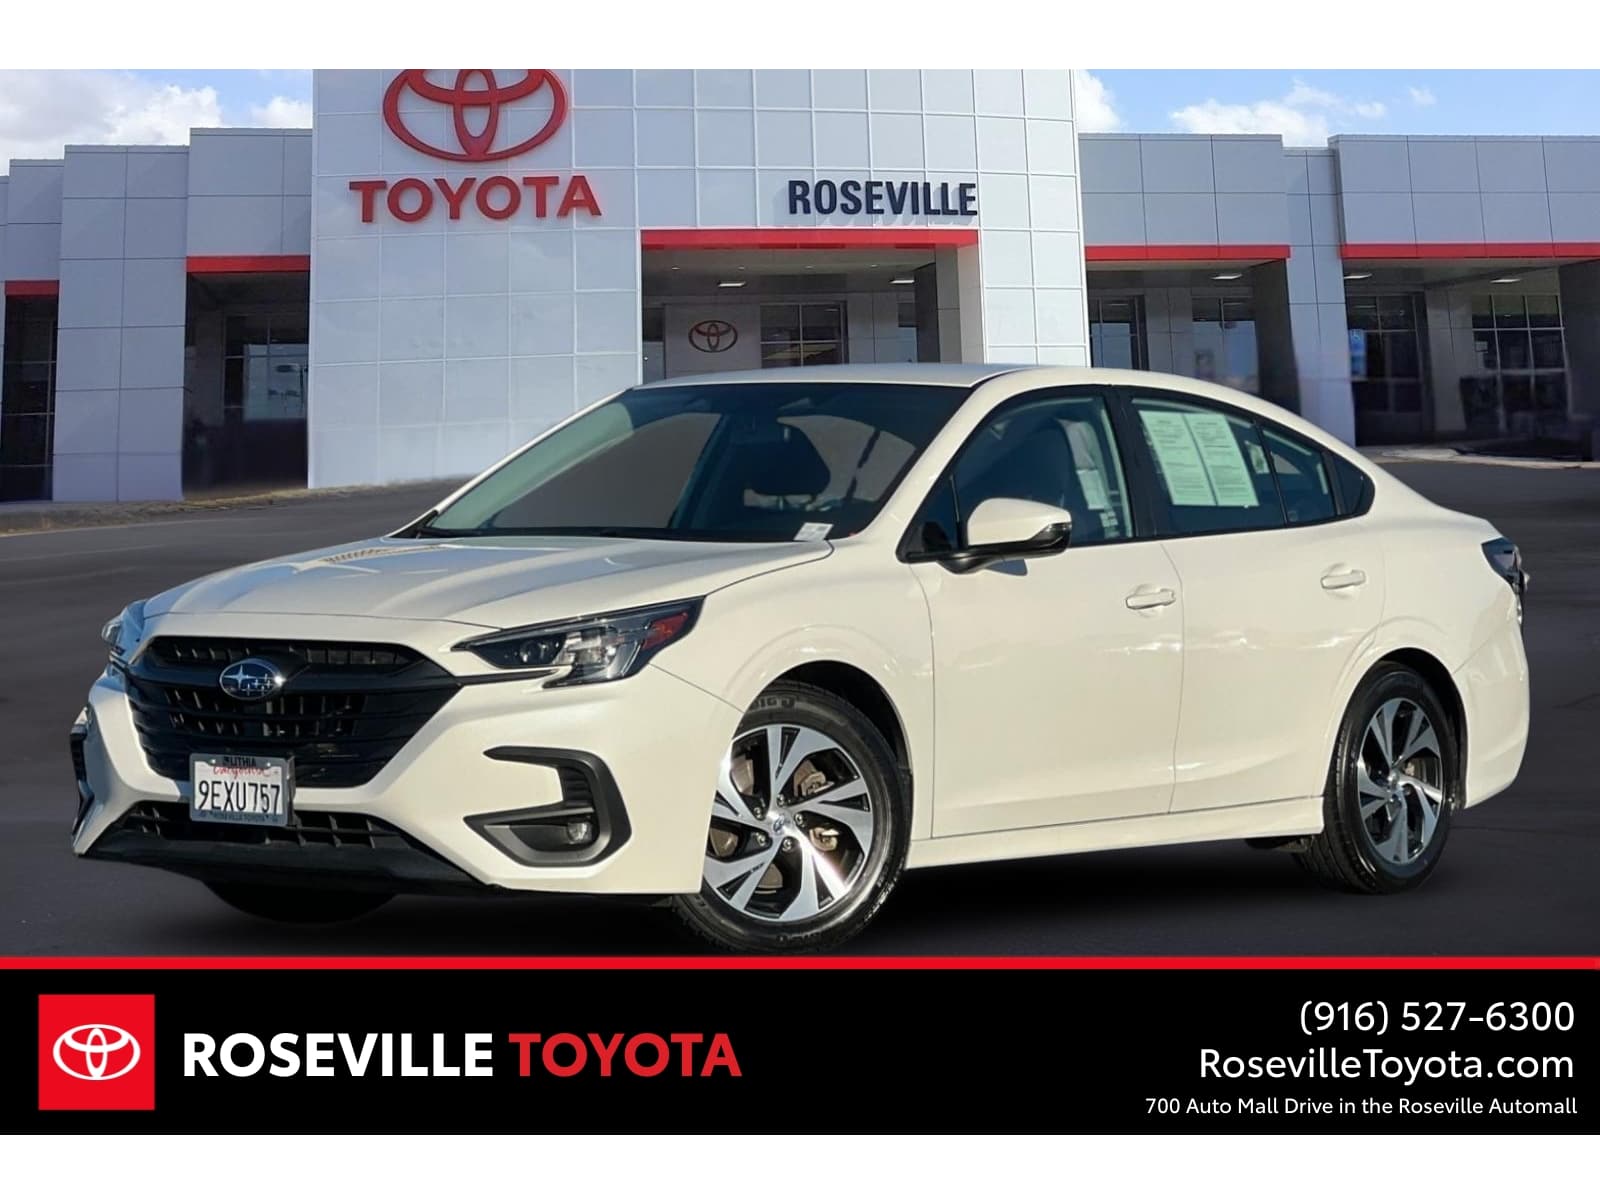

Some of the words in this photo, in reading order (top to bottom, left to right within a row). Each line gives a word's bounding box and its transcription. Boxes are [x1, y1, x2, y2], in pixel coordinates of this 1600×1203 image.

[349, 175, 602, 223] TOYOTA
[788, 179, 978, 216] ROSEVILLE
[230, 757, 257, 767] LITHIA
[199, 780, 280, 815] 9EXU757
